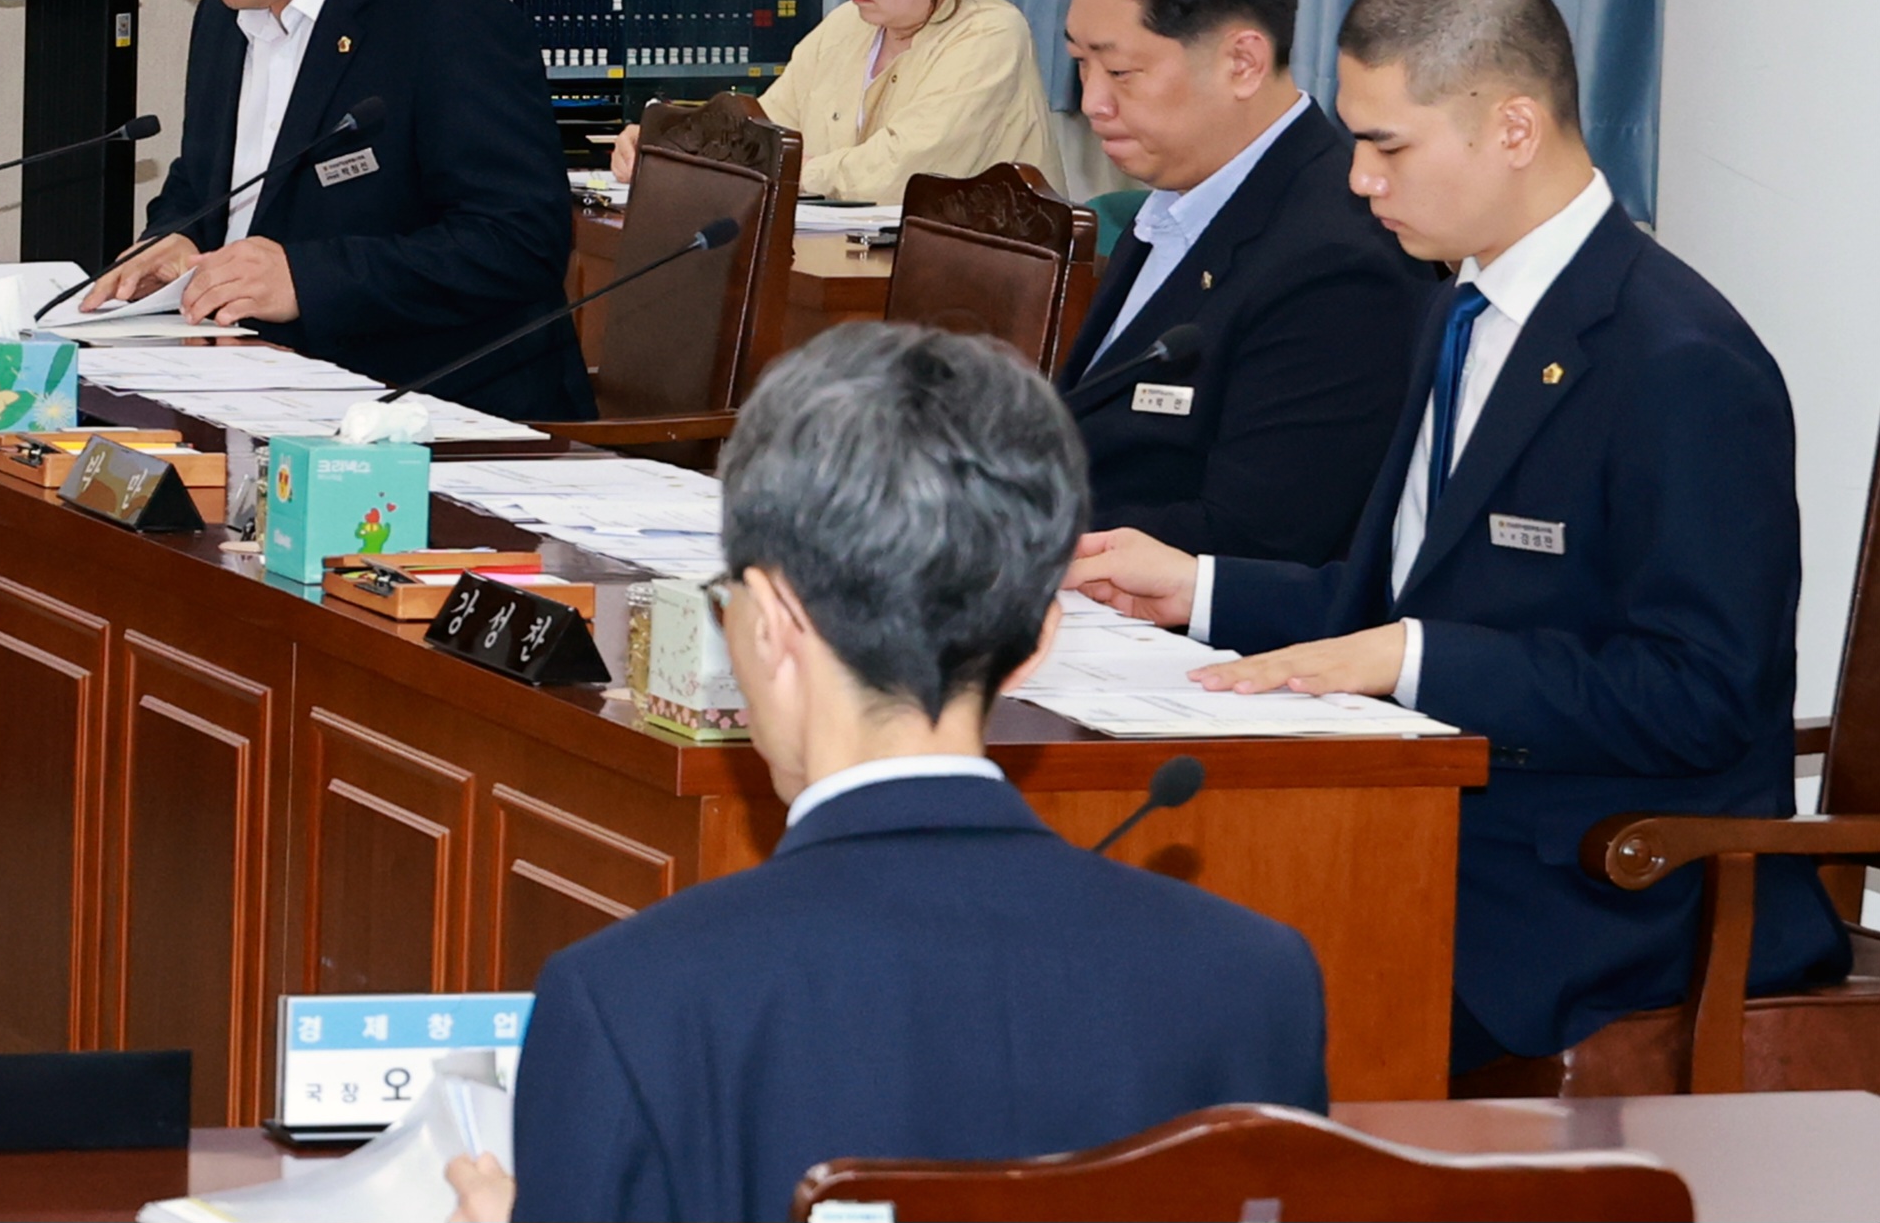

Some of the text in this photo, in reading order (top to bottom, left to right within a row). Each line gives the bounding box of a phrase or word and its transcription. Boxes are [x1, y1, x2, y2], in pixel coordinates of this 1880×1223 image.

[448, 589, 552, 662] 강성찬
[305, 1067, 412, 1103] 국장 오
